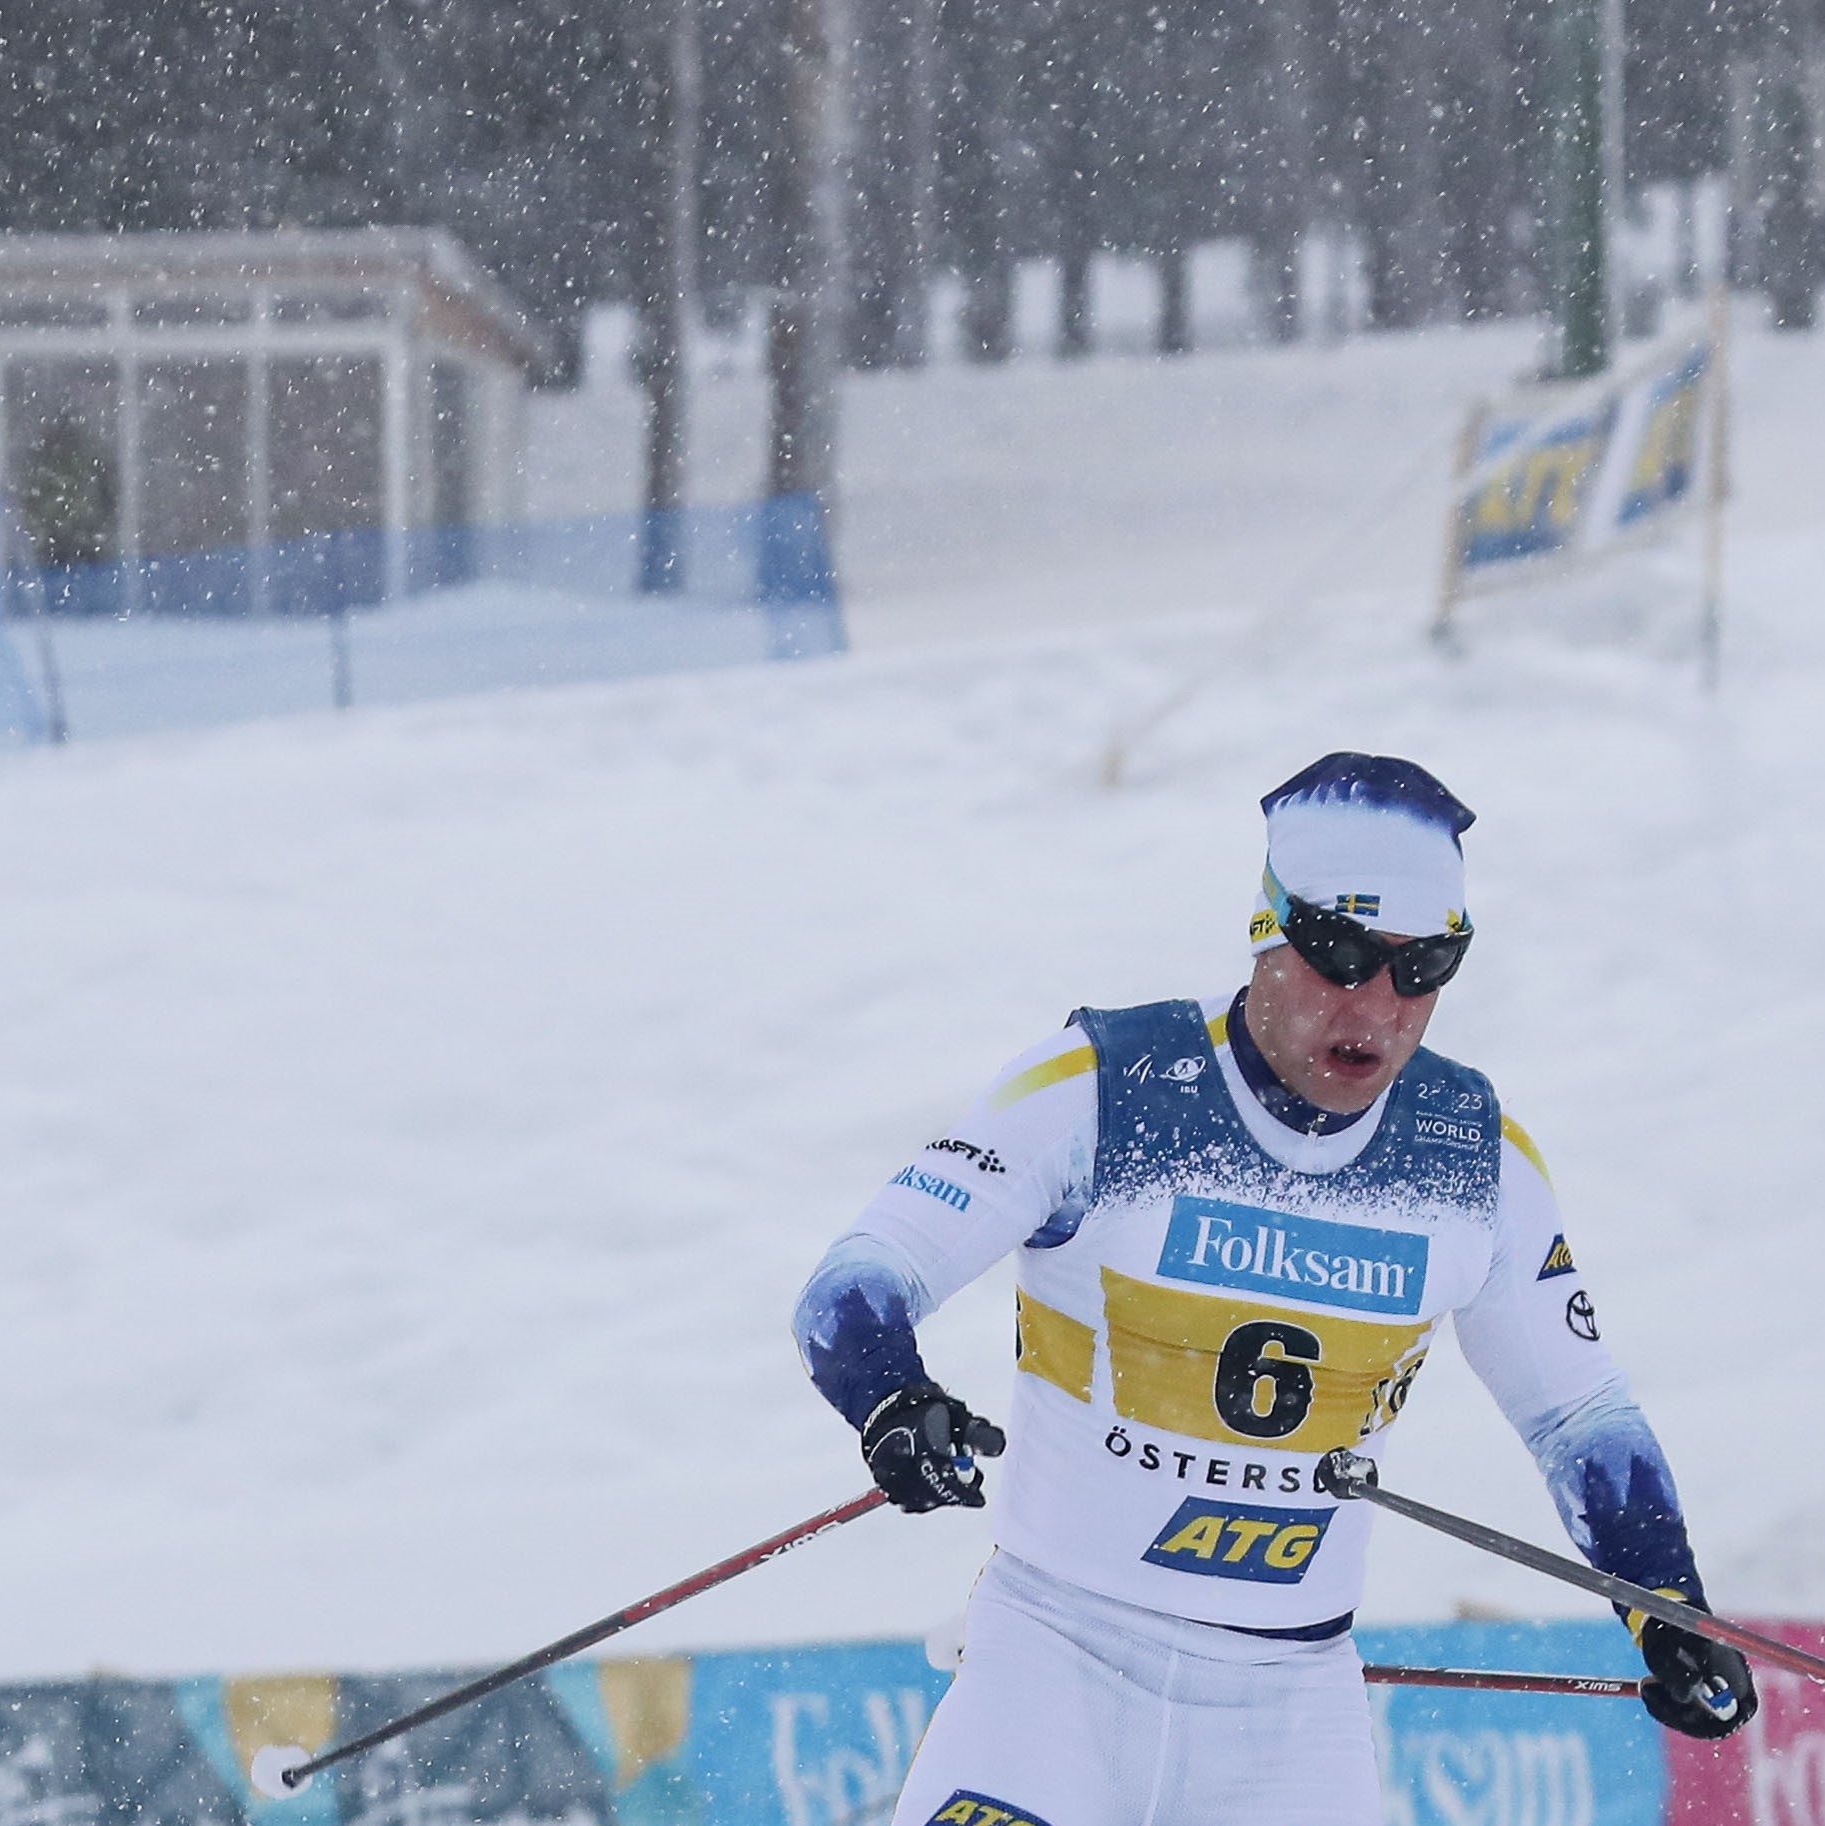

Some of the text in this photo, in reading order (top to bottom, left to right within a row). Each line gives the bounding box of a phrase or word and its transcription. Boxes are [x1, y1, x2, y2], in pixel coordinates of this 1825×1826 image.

[1416, 1119, 1481, 1142] WORLD
[1194, 1216, 1413, 1298] Folksam
[1214, 1322, 1321, 1439] 6
[1159, 1516, 1320, 1569] ATG
